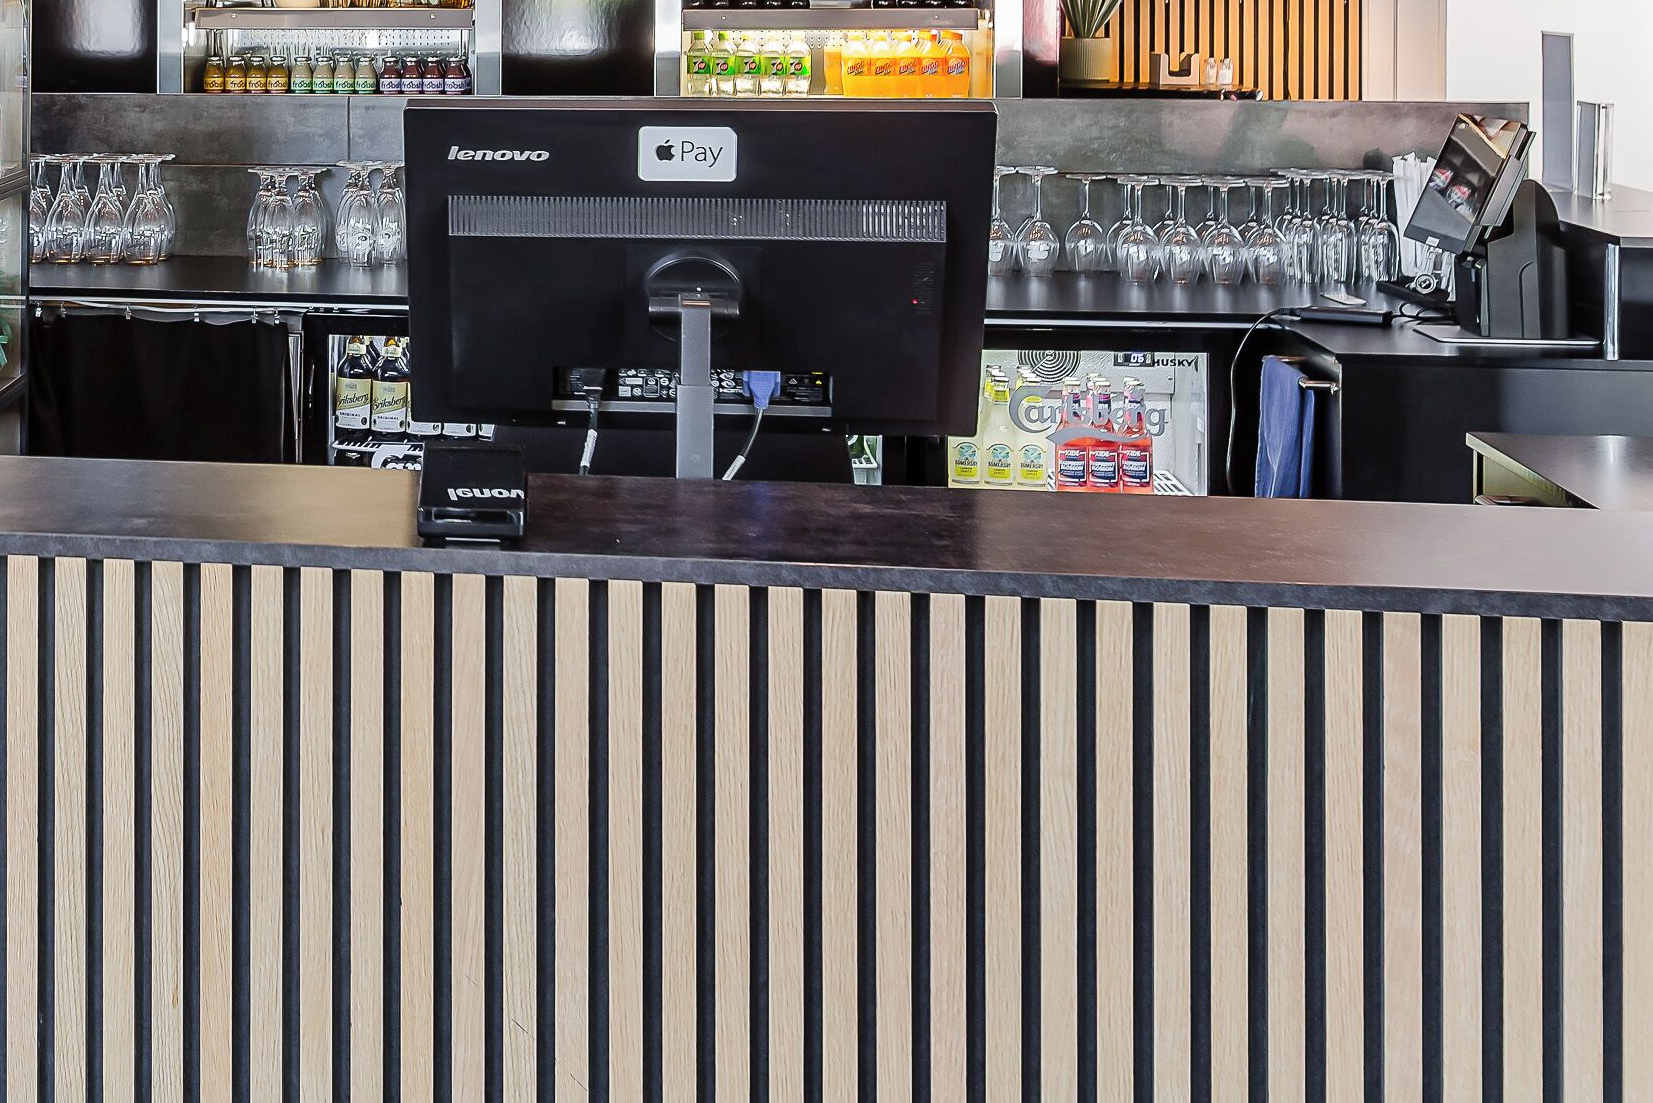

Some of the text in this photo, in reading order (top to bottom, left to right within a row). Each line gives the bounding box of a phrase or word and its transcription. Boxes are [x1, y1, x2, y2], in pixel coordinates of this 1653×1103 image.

[447, 145, 550, 162] lenovo
[680, 140, 724, 168] Pay
[1153, 358, 1195, 367] HUSKY
[1008, 385, 1169, 437] Carlsberg
